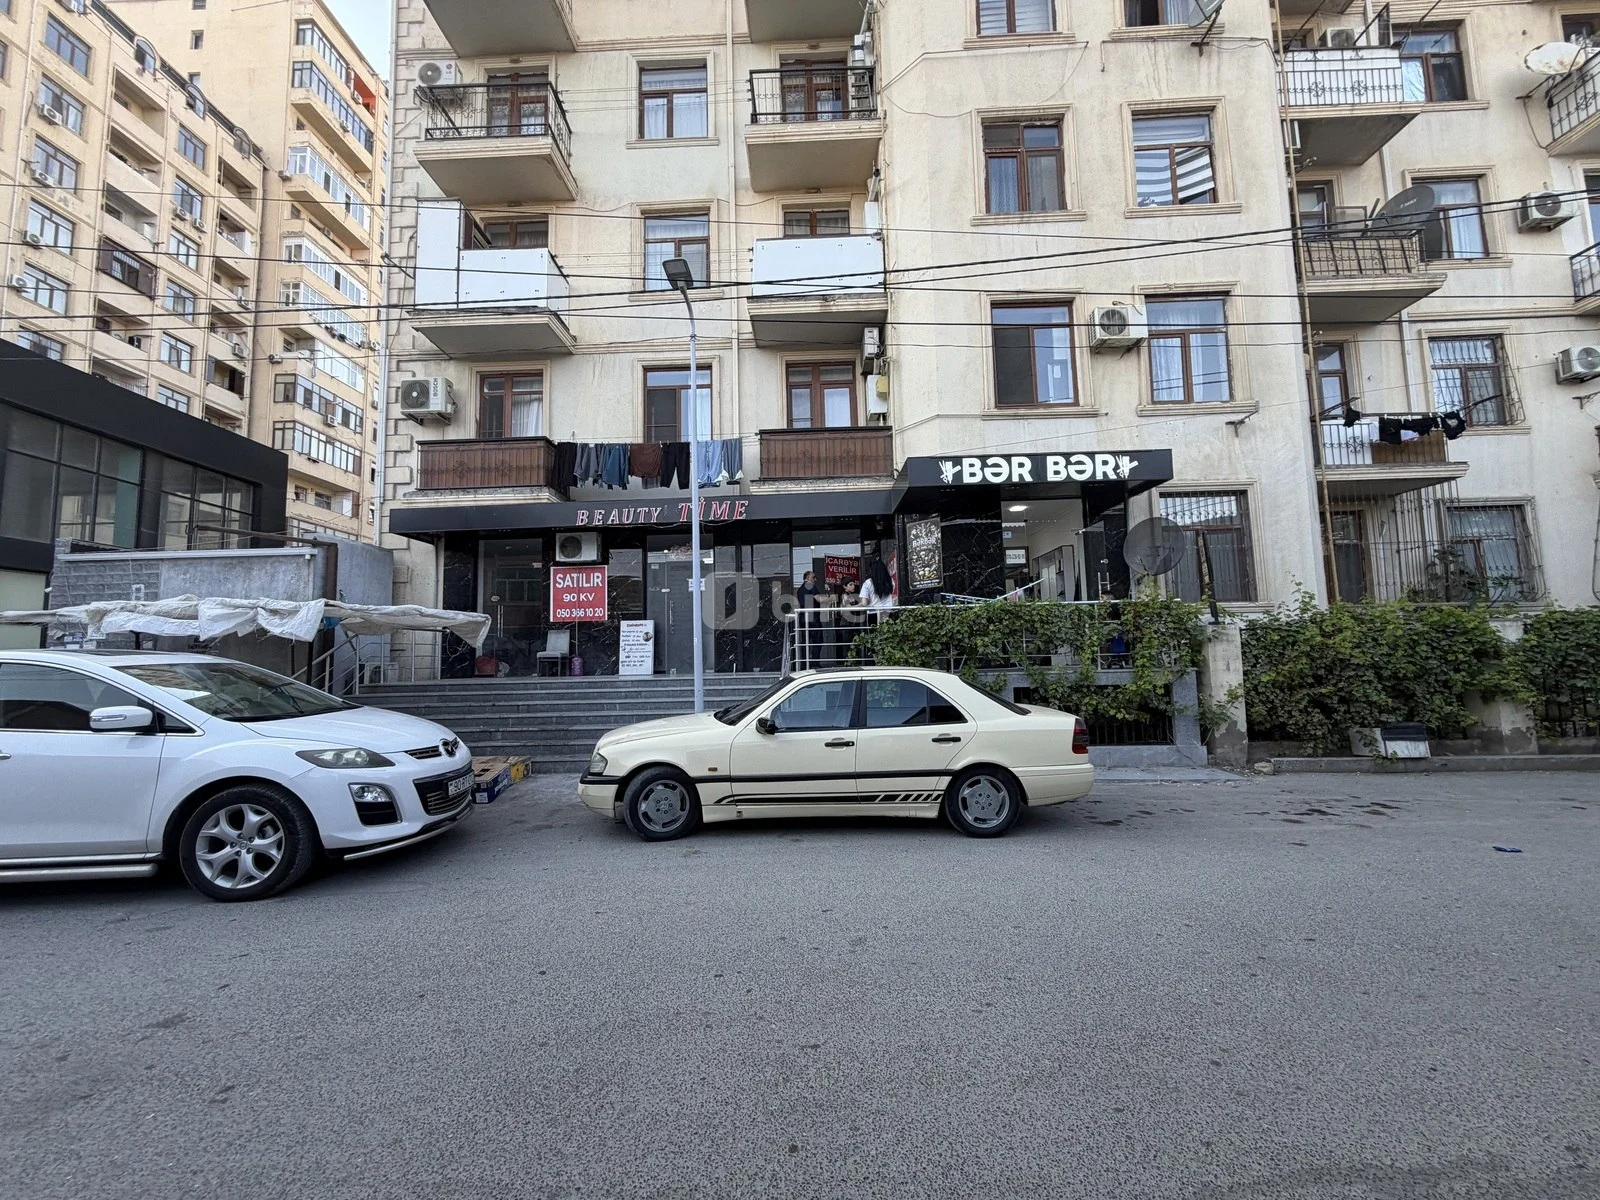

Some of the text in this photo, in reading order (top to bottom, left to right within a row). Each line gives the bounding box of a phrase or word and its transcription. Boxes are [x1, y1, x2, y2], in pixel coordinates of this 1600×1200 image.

[962, 454, 1117, 483] BƏR BƏR
[576, 507, 662, 526] BEAUTY
[556, 572, 603, 588] SATILIR
[563, 592, 595, 602] 90 KV
[556, 608, 571, 618] 050
[586, 608, 594, 617] 10
[594, 607, 604, 617] 20
